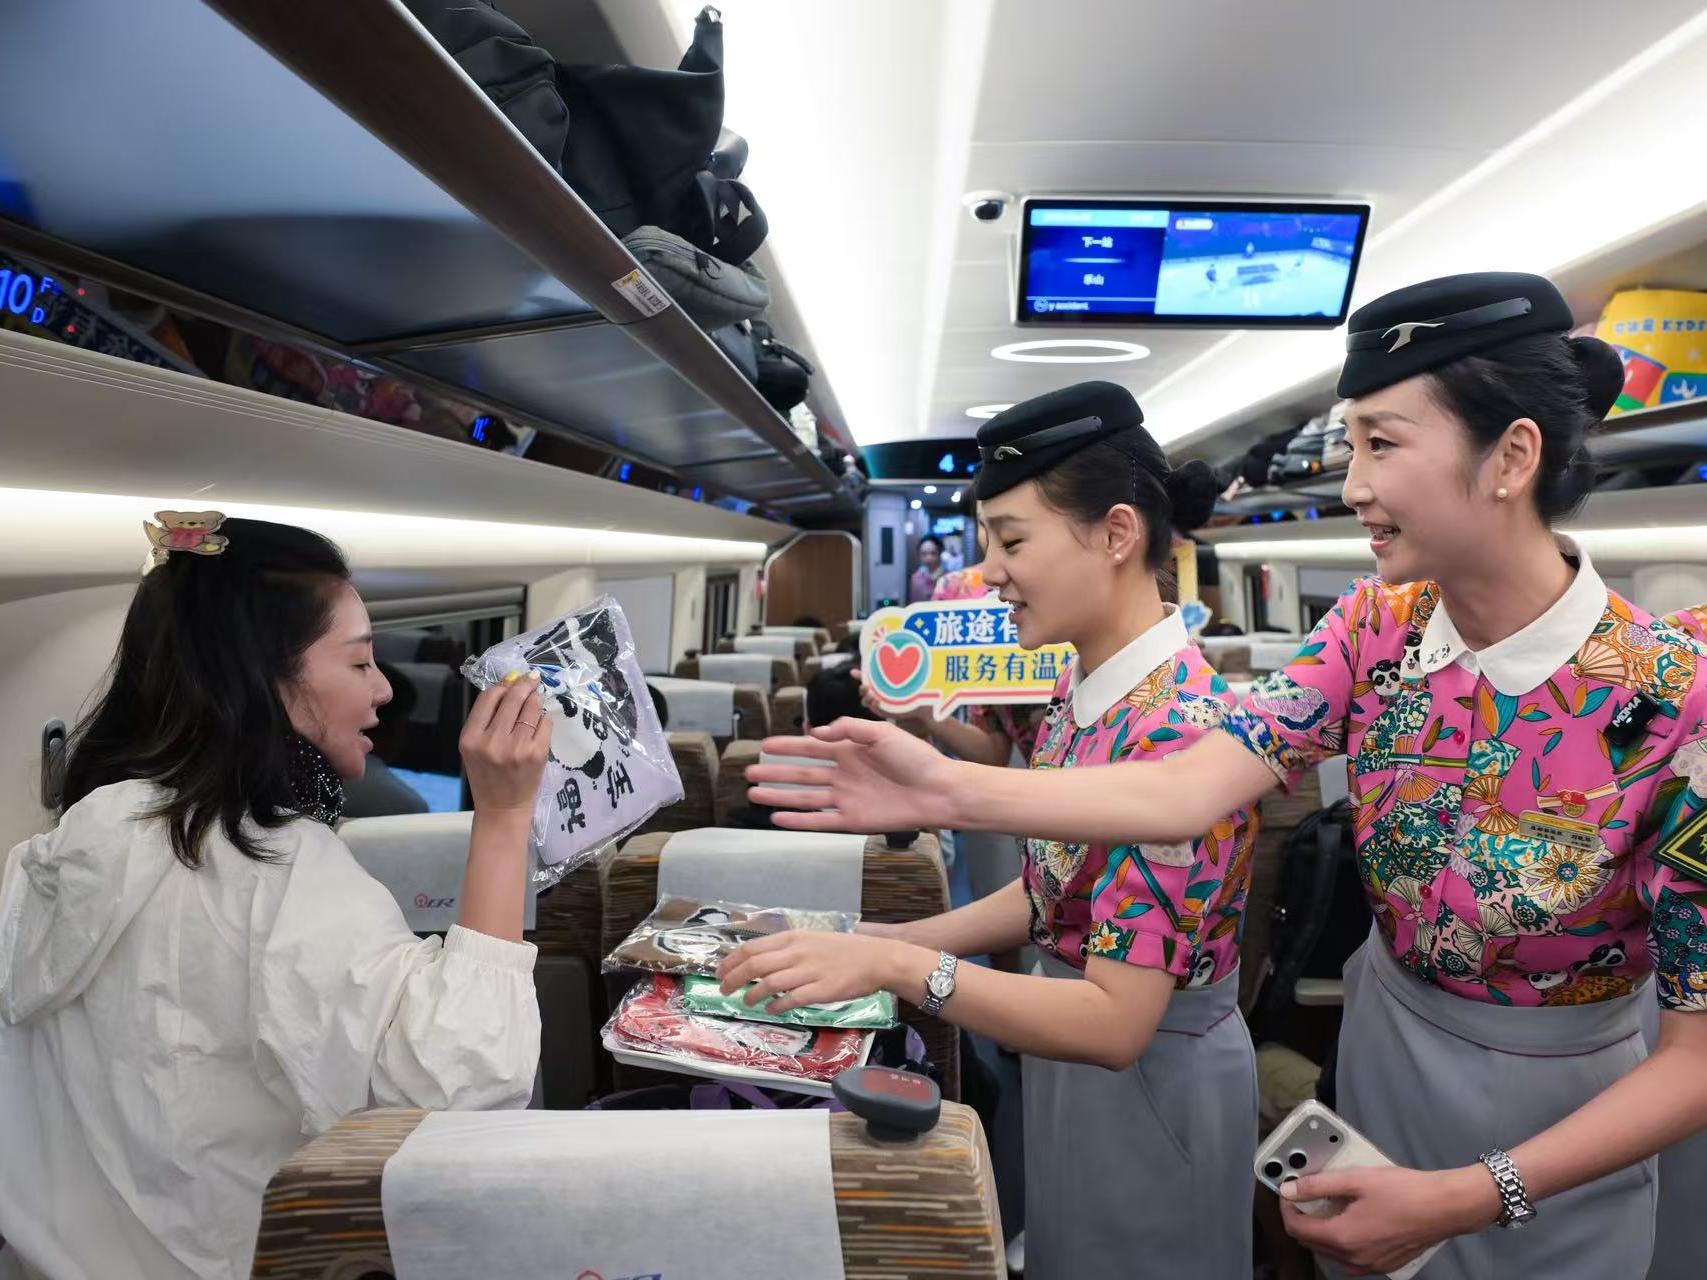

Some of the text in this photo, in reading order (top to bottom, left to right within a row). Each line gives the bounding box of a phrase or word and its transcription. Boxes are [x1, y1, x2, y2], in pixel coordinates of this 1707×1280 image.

[0, 270, 53, 314] 10 F
[32, 307, 45, 323] D
